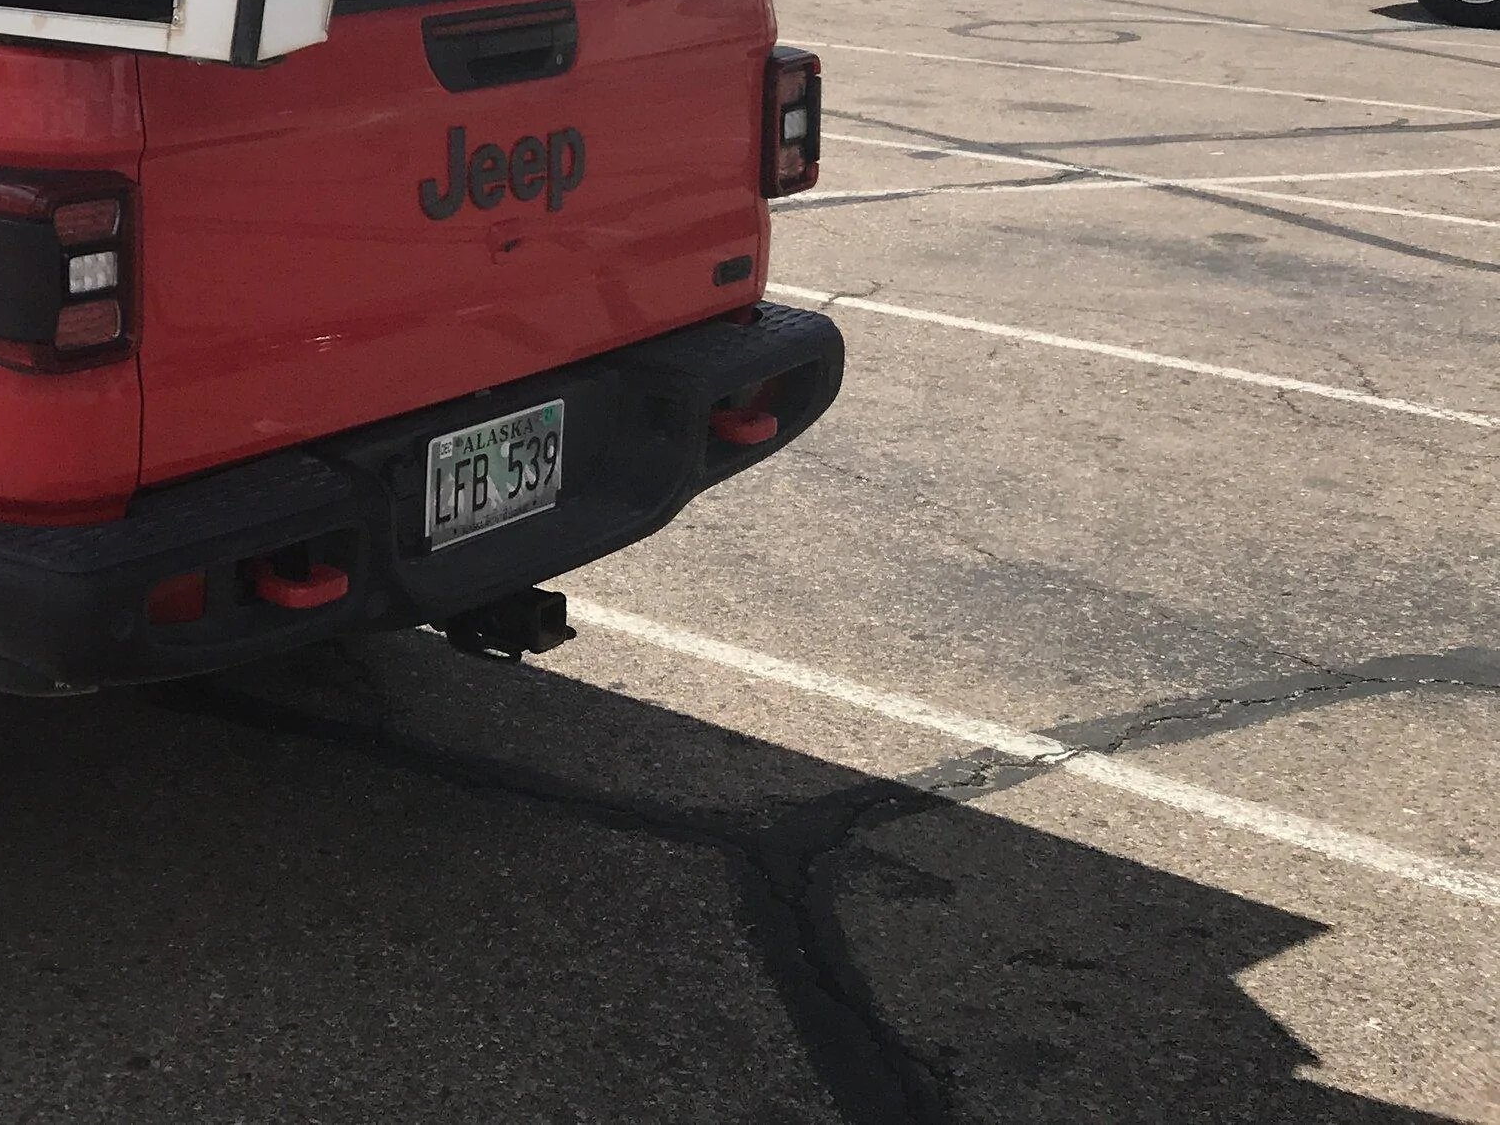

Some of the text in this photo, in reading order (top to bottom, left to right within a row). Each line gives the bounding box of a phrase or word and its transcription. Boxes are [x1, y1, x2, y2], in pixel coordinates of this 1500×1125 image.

[418, 126, 586, 221] Jeep
[435, 453, 490, 525] LFB
[507, 430, 559, 500] 539
[463, 417, 534, 454] ALASKA
